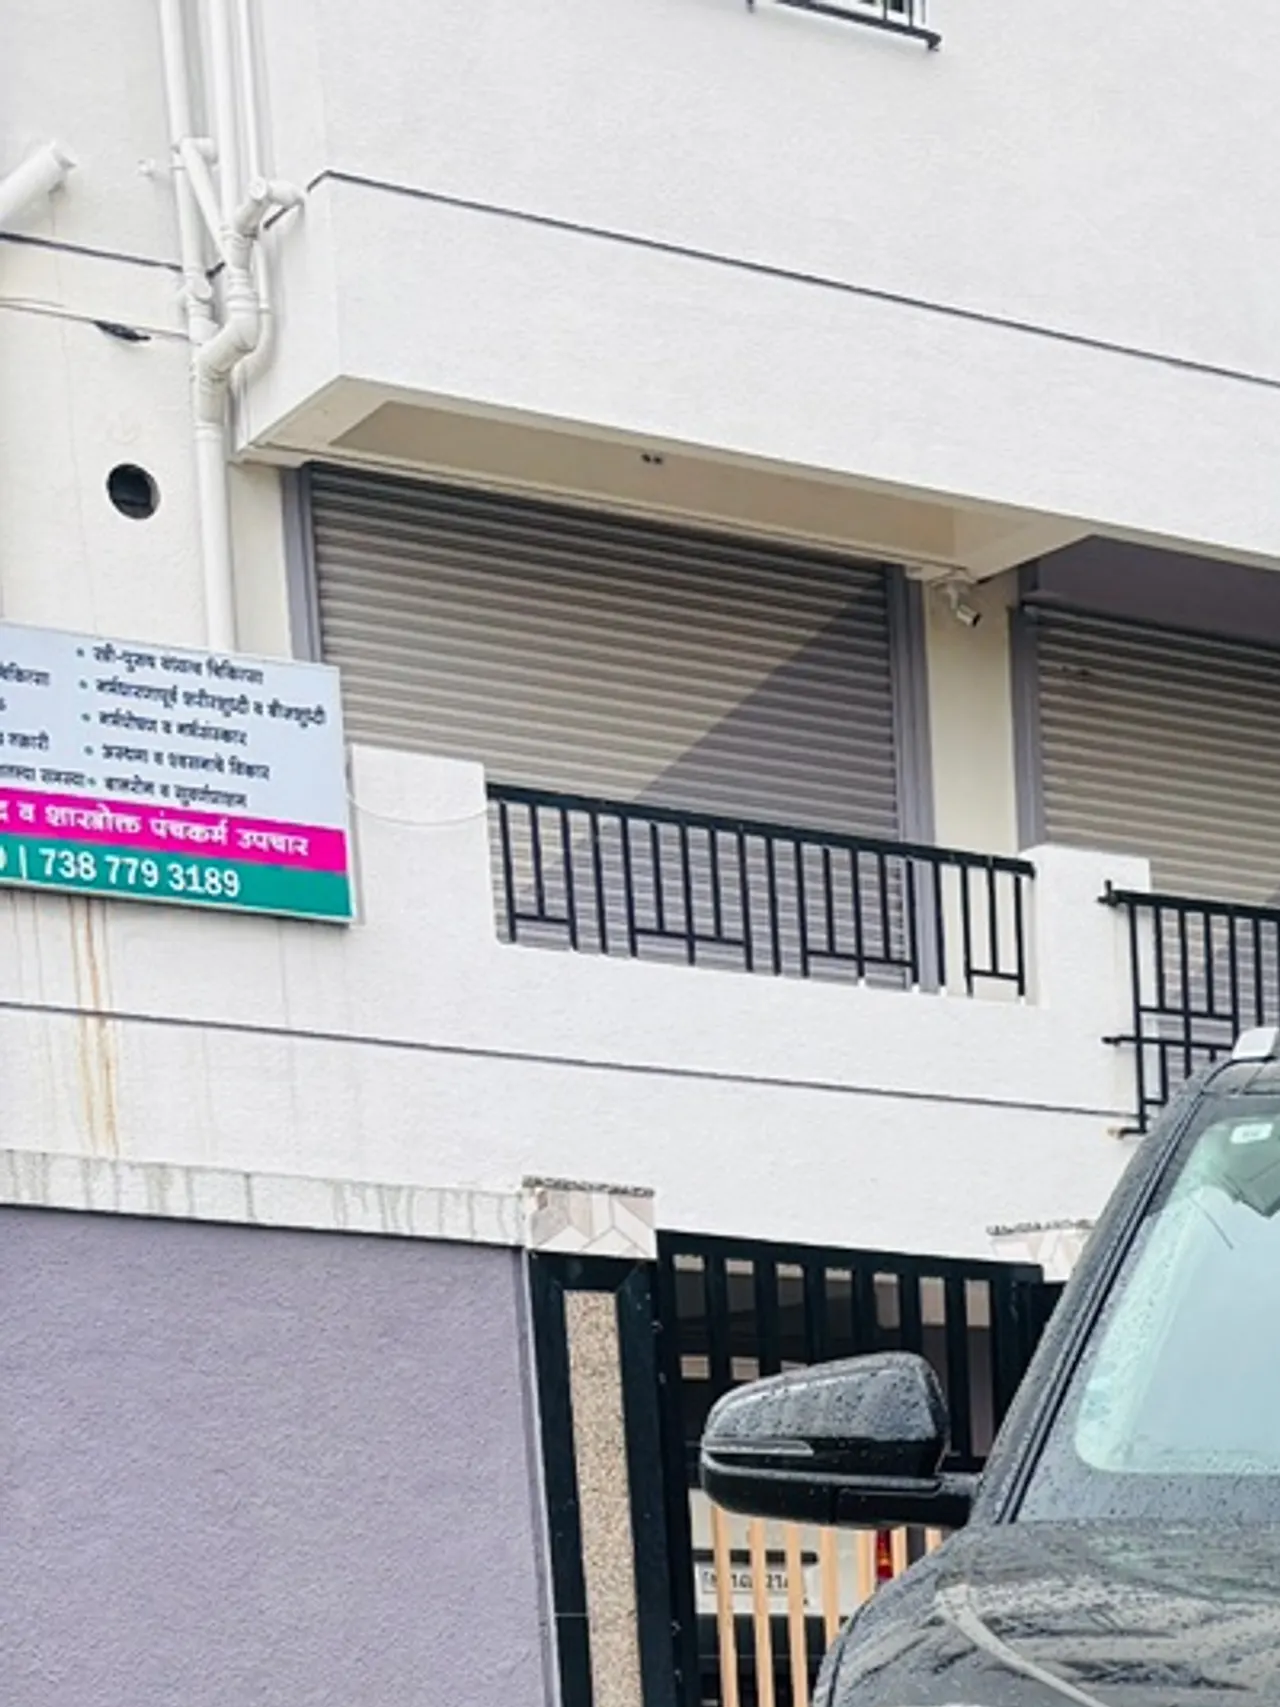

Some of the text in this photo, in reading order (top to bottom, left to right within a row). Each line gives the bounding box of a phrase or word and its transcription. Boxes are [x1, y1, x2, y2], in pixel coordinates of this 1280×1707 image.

[38, 848, 97, 881] 738
[104, 855, 159, 888] 779
[167, 863, 241, 898] 3189
